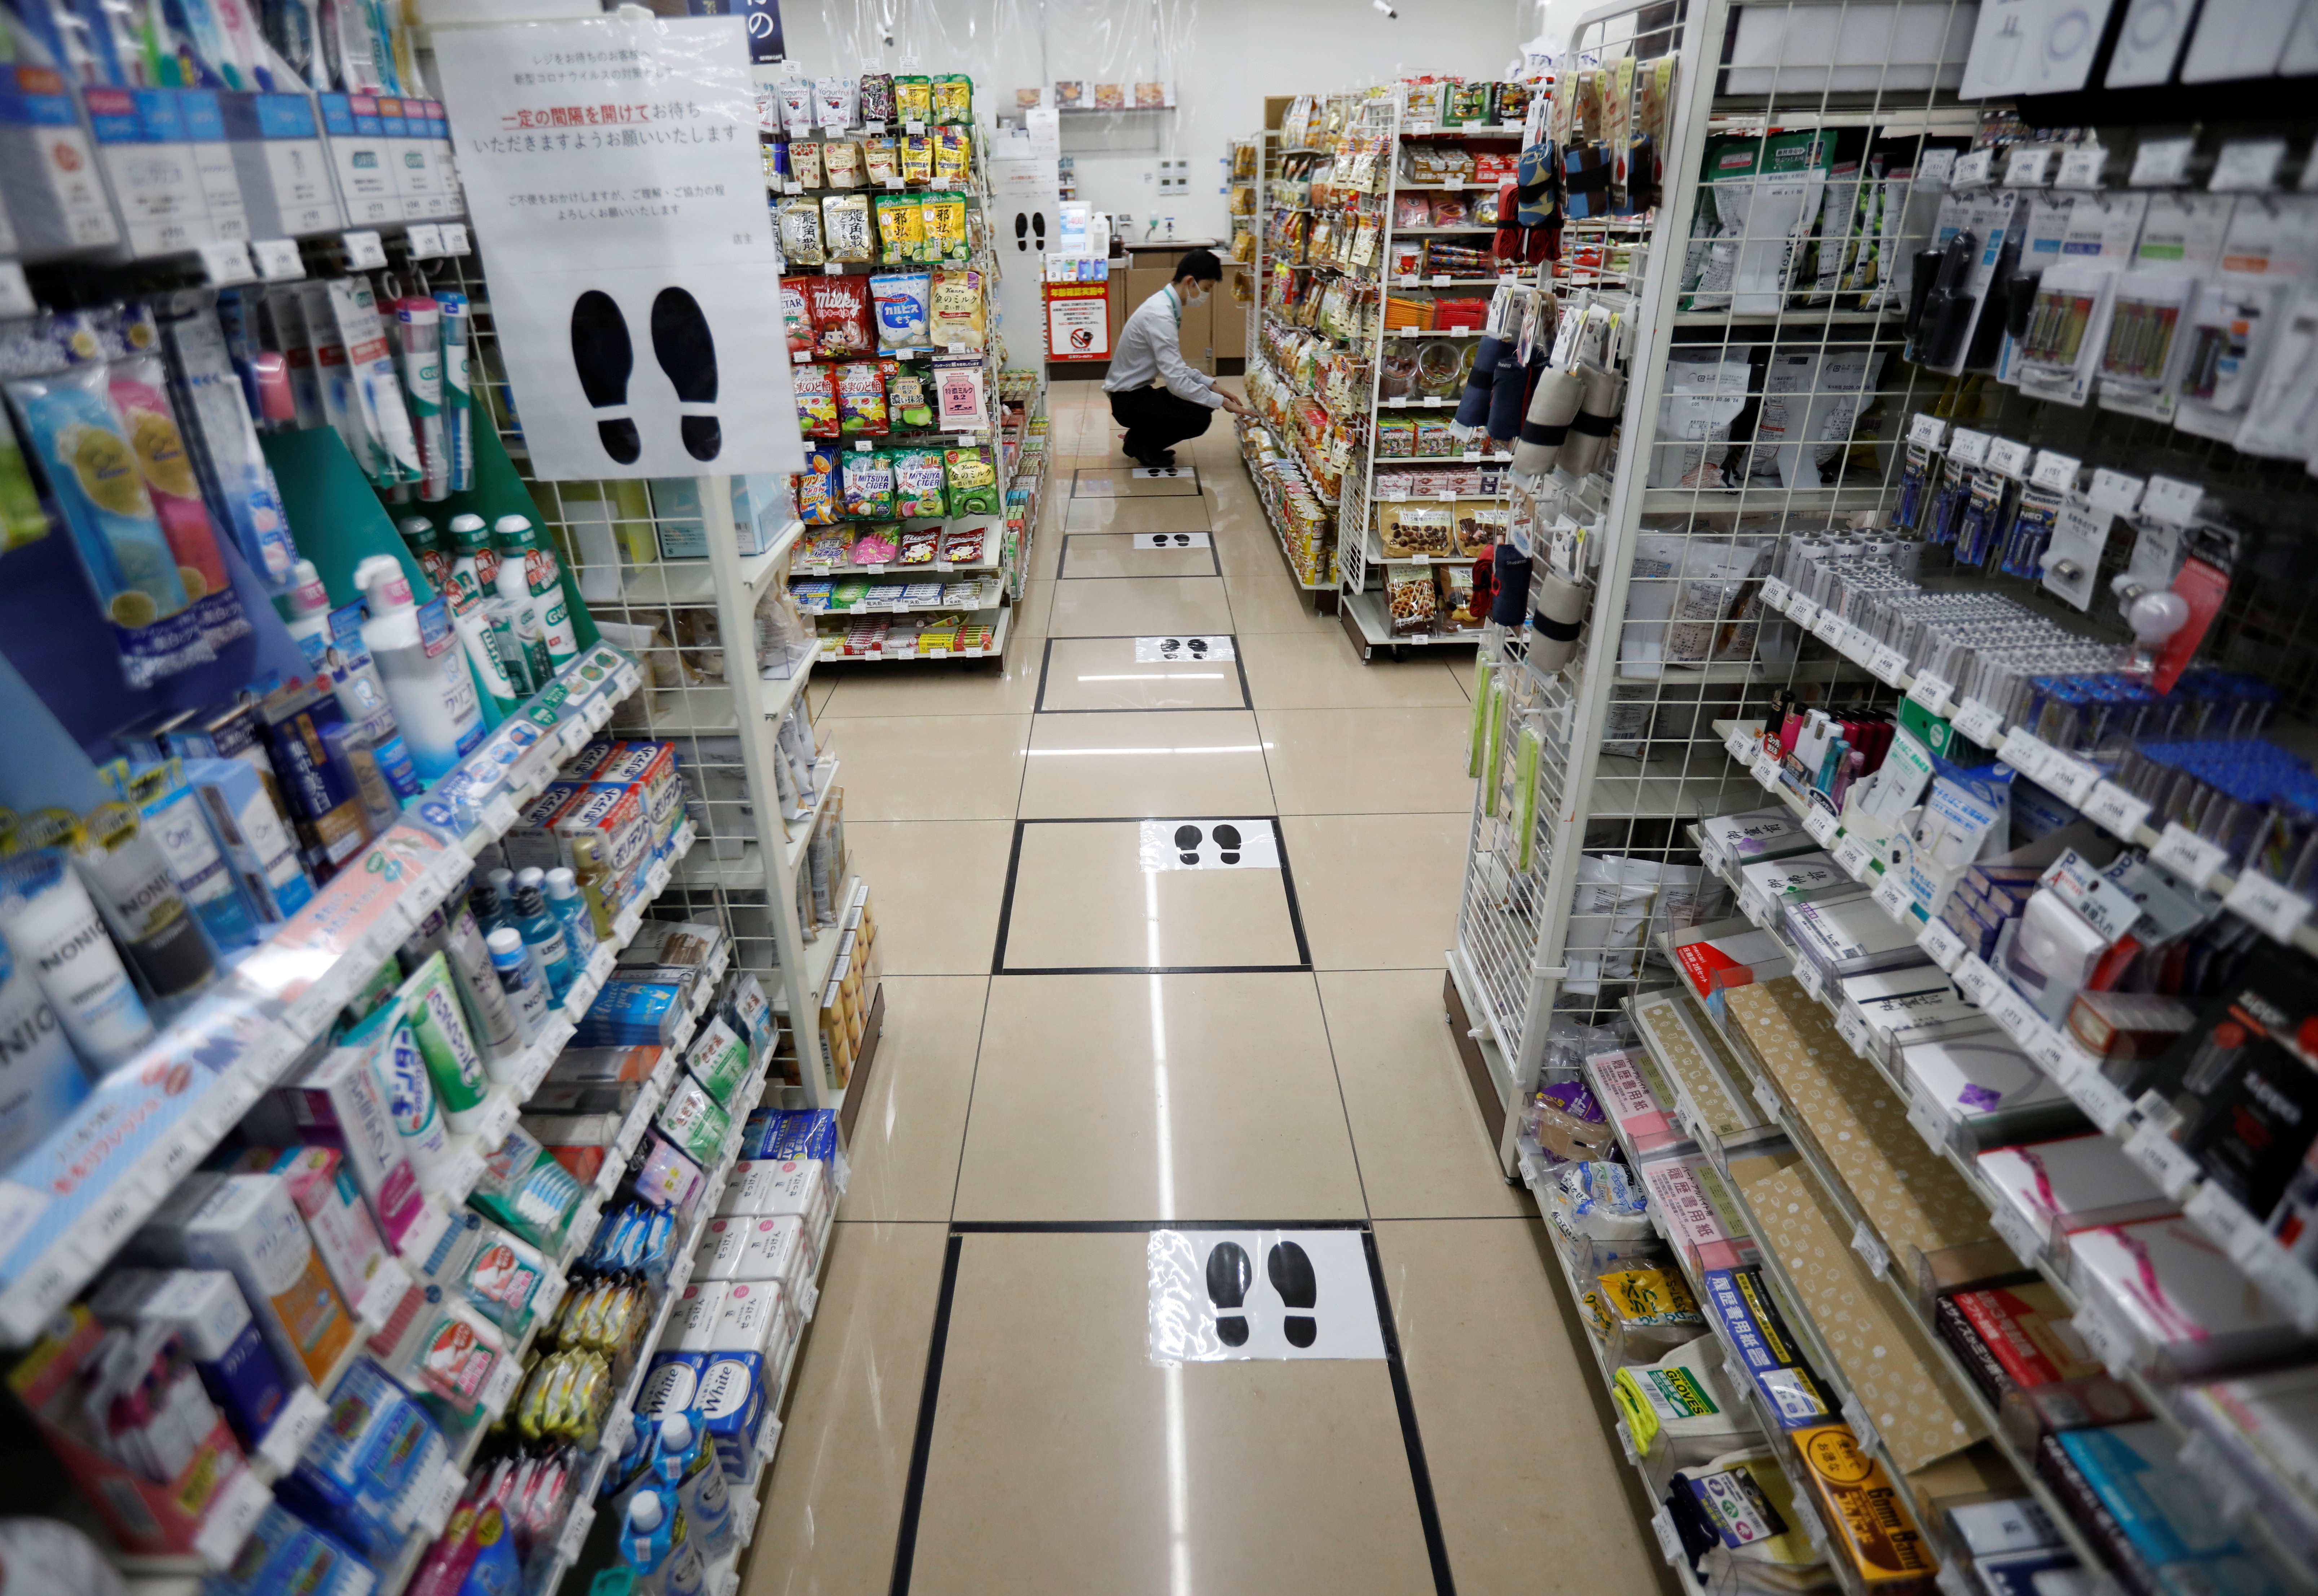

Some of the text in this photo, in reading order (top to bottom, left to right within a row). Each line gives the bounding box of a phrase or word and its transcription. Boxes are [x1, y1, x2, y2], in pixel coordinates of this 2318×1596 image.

[501, 101, 700, 128] 一定の間隔を開けてお待ち
[474, 125, 737, 153] いただきますようお願いいたします
[801, 210, 820, 260] 龍角散の
[848, 209, 866, 257] 龍角散の
[814, 291, 862, 319] Milky
[934, 292, 978, 304] 金のミルク
[884, 304, 919, 316] カルピス
[895, 315, 911, 324] もち
[794, 380, 832, 393] 実のど飴
[839, 380, 882, 393] 果実のど飴
[890, 393, 924, 405] 濃い抹茶
[1908, 448, 1927, 462] Panasonic
[949, 469, 992, 481] 金のミルク
[1973, 480, 2000, 497] Panasonic
[2024, 492, 2062, 506] Panason
[1970, 496, 1984, 507] NEO
[2020, 511, 2044, 521] NEO
[1768, 587, 1779, 596] ¥332
[1824, 623, 1836, 634] ¥285
[1734, 740, 1744, 750] ¥150
[574, 745, 607, 774] ポリデント
[623, 746, 657, 776] ポリデント
[529, 788, 570, 821] ポリデント
[582, 789, 619, 821] ポリデント
[1814, 818, 1826, 830] ¥114
[614, 816, 648, 868] ポリデント
[1844, 850, 1858, 863] ¥250
[1682, 947, 1708, 983] 圧縮袋 2枚セット
[1691, 945, 1707, 964] mercari
[1611, 1059, 1649, 1112] 履歴書用紙
[1625, 1058, 1650, 1095] パート・アルバイト用
[1666, 1168, 1715, 1238] 履歴書用紙
[1681, 1166, 1714, 1217] パート・アルバイト用
[1711, 1276, 1760, 1349] 履歴書用紙
[704, 1365, 733, 1412] White
[1675, 1368, 1690, 1386] WORK
[649, 1368, 679, 1414] White
[1666, 1370, 1704, 1416] GLOVES
